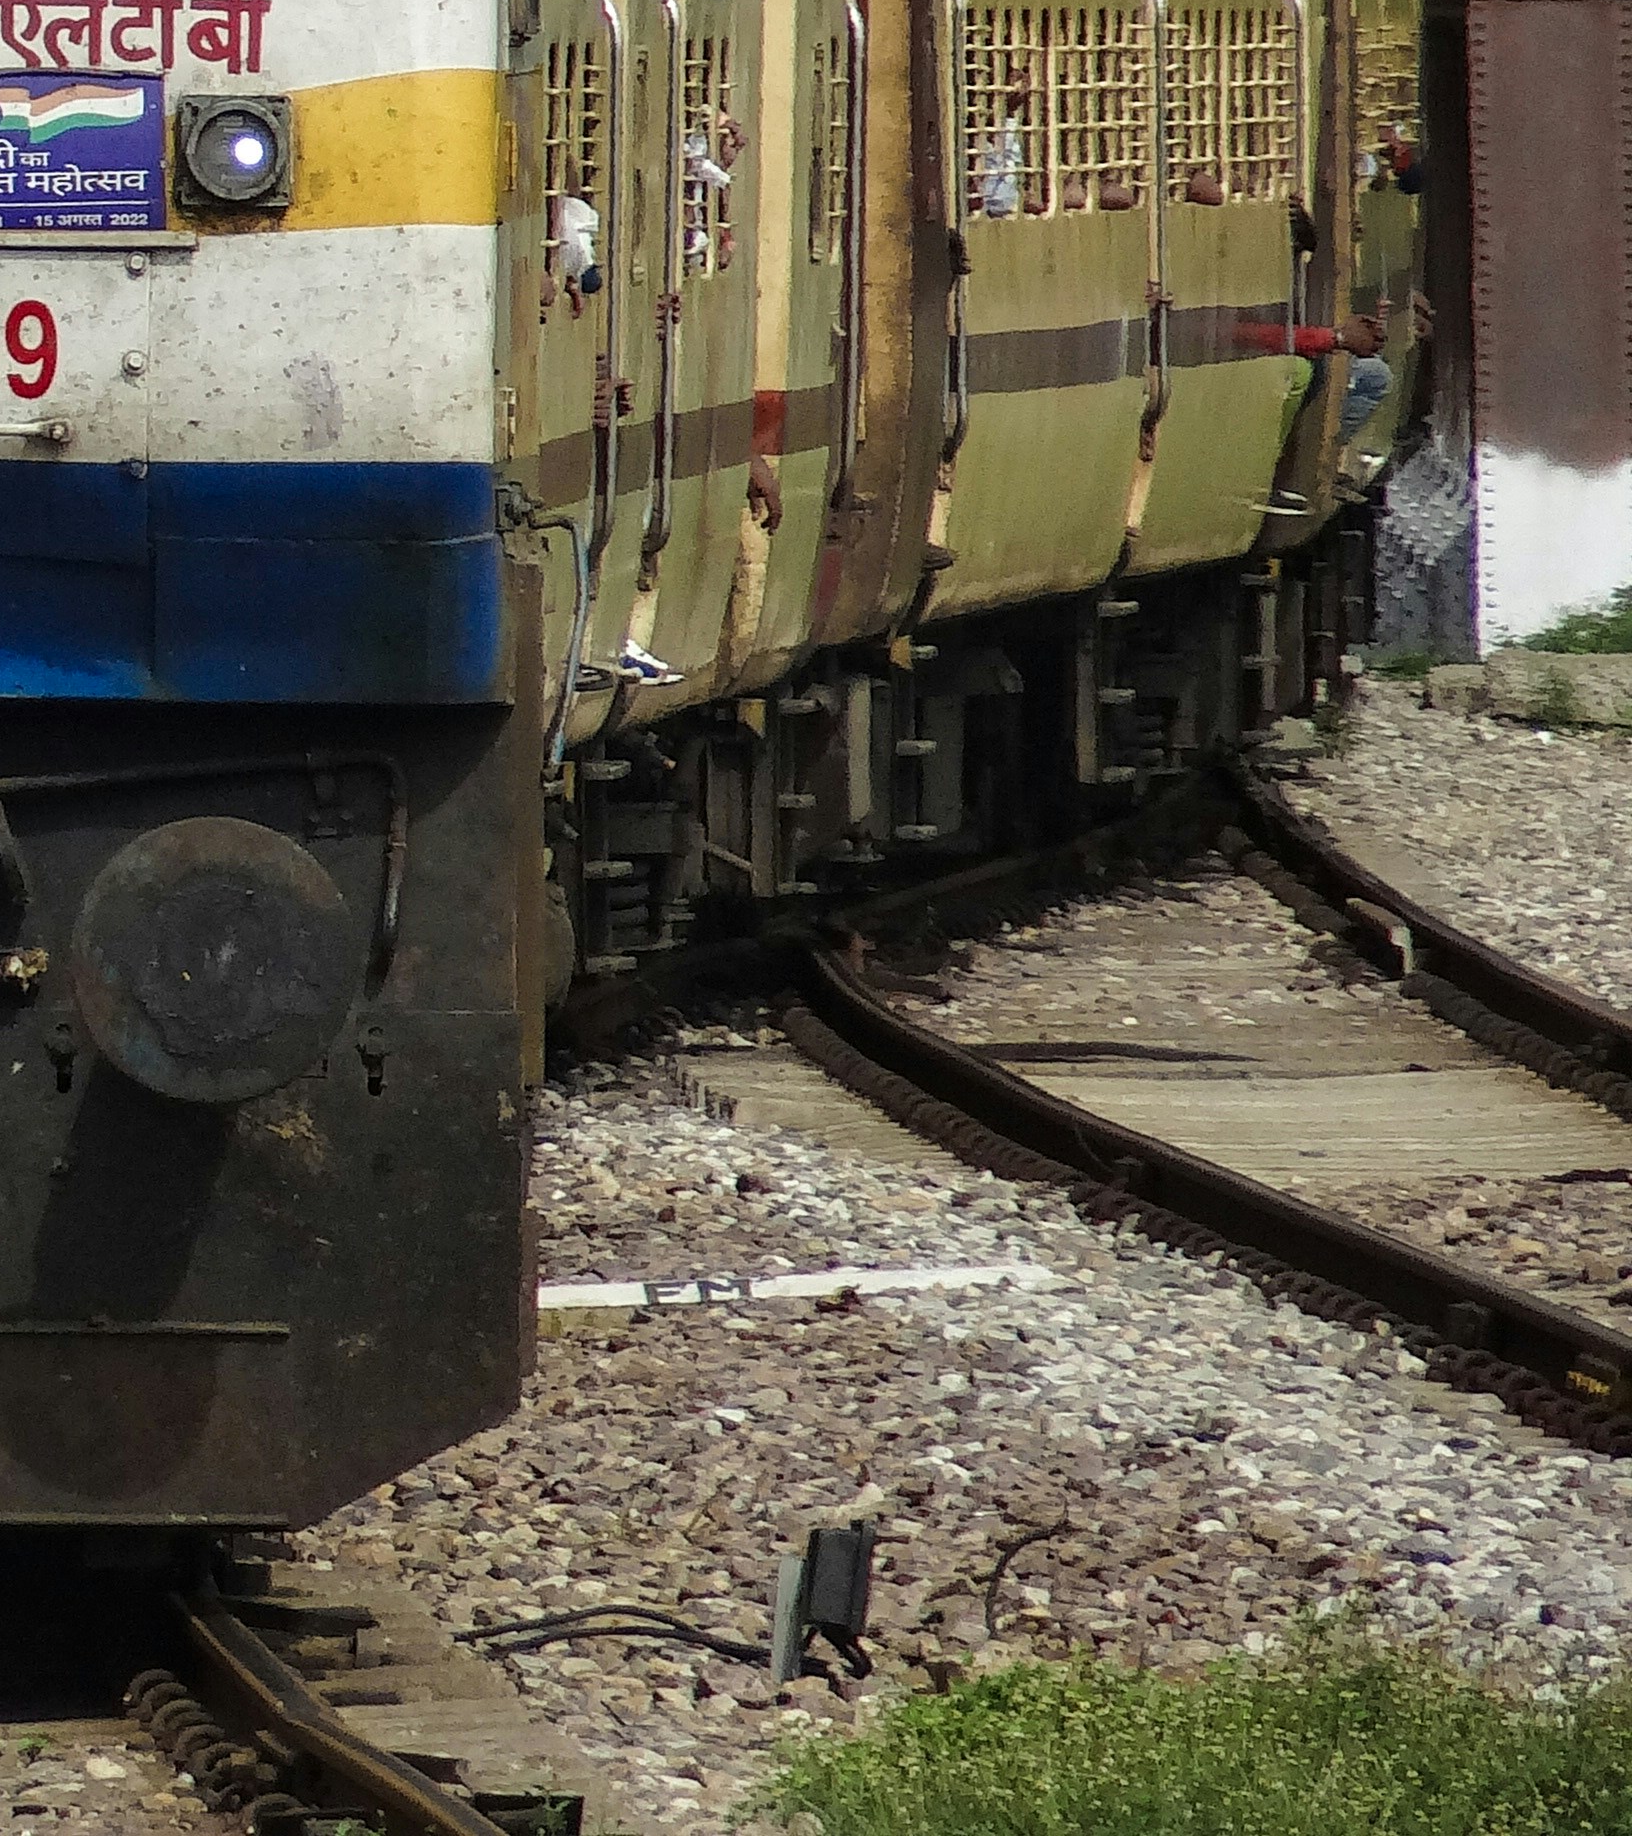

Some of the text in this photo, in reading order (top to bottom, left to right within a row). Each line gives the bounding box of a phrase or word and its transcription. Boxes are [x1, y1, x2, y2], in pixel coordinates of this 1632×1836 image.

[19, 151, 51, 168] का
[25, 164, 150, 197] महोत्सव
[34, 215, 54, 228] 15
[110, 213, 149, 226] 2022
